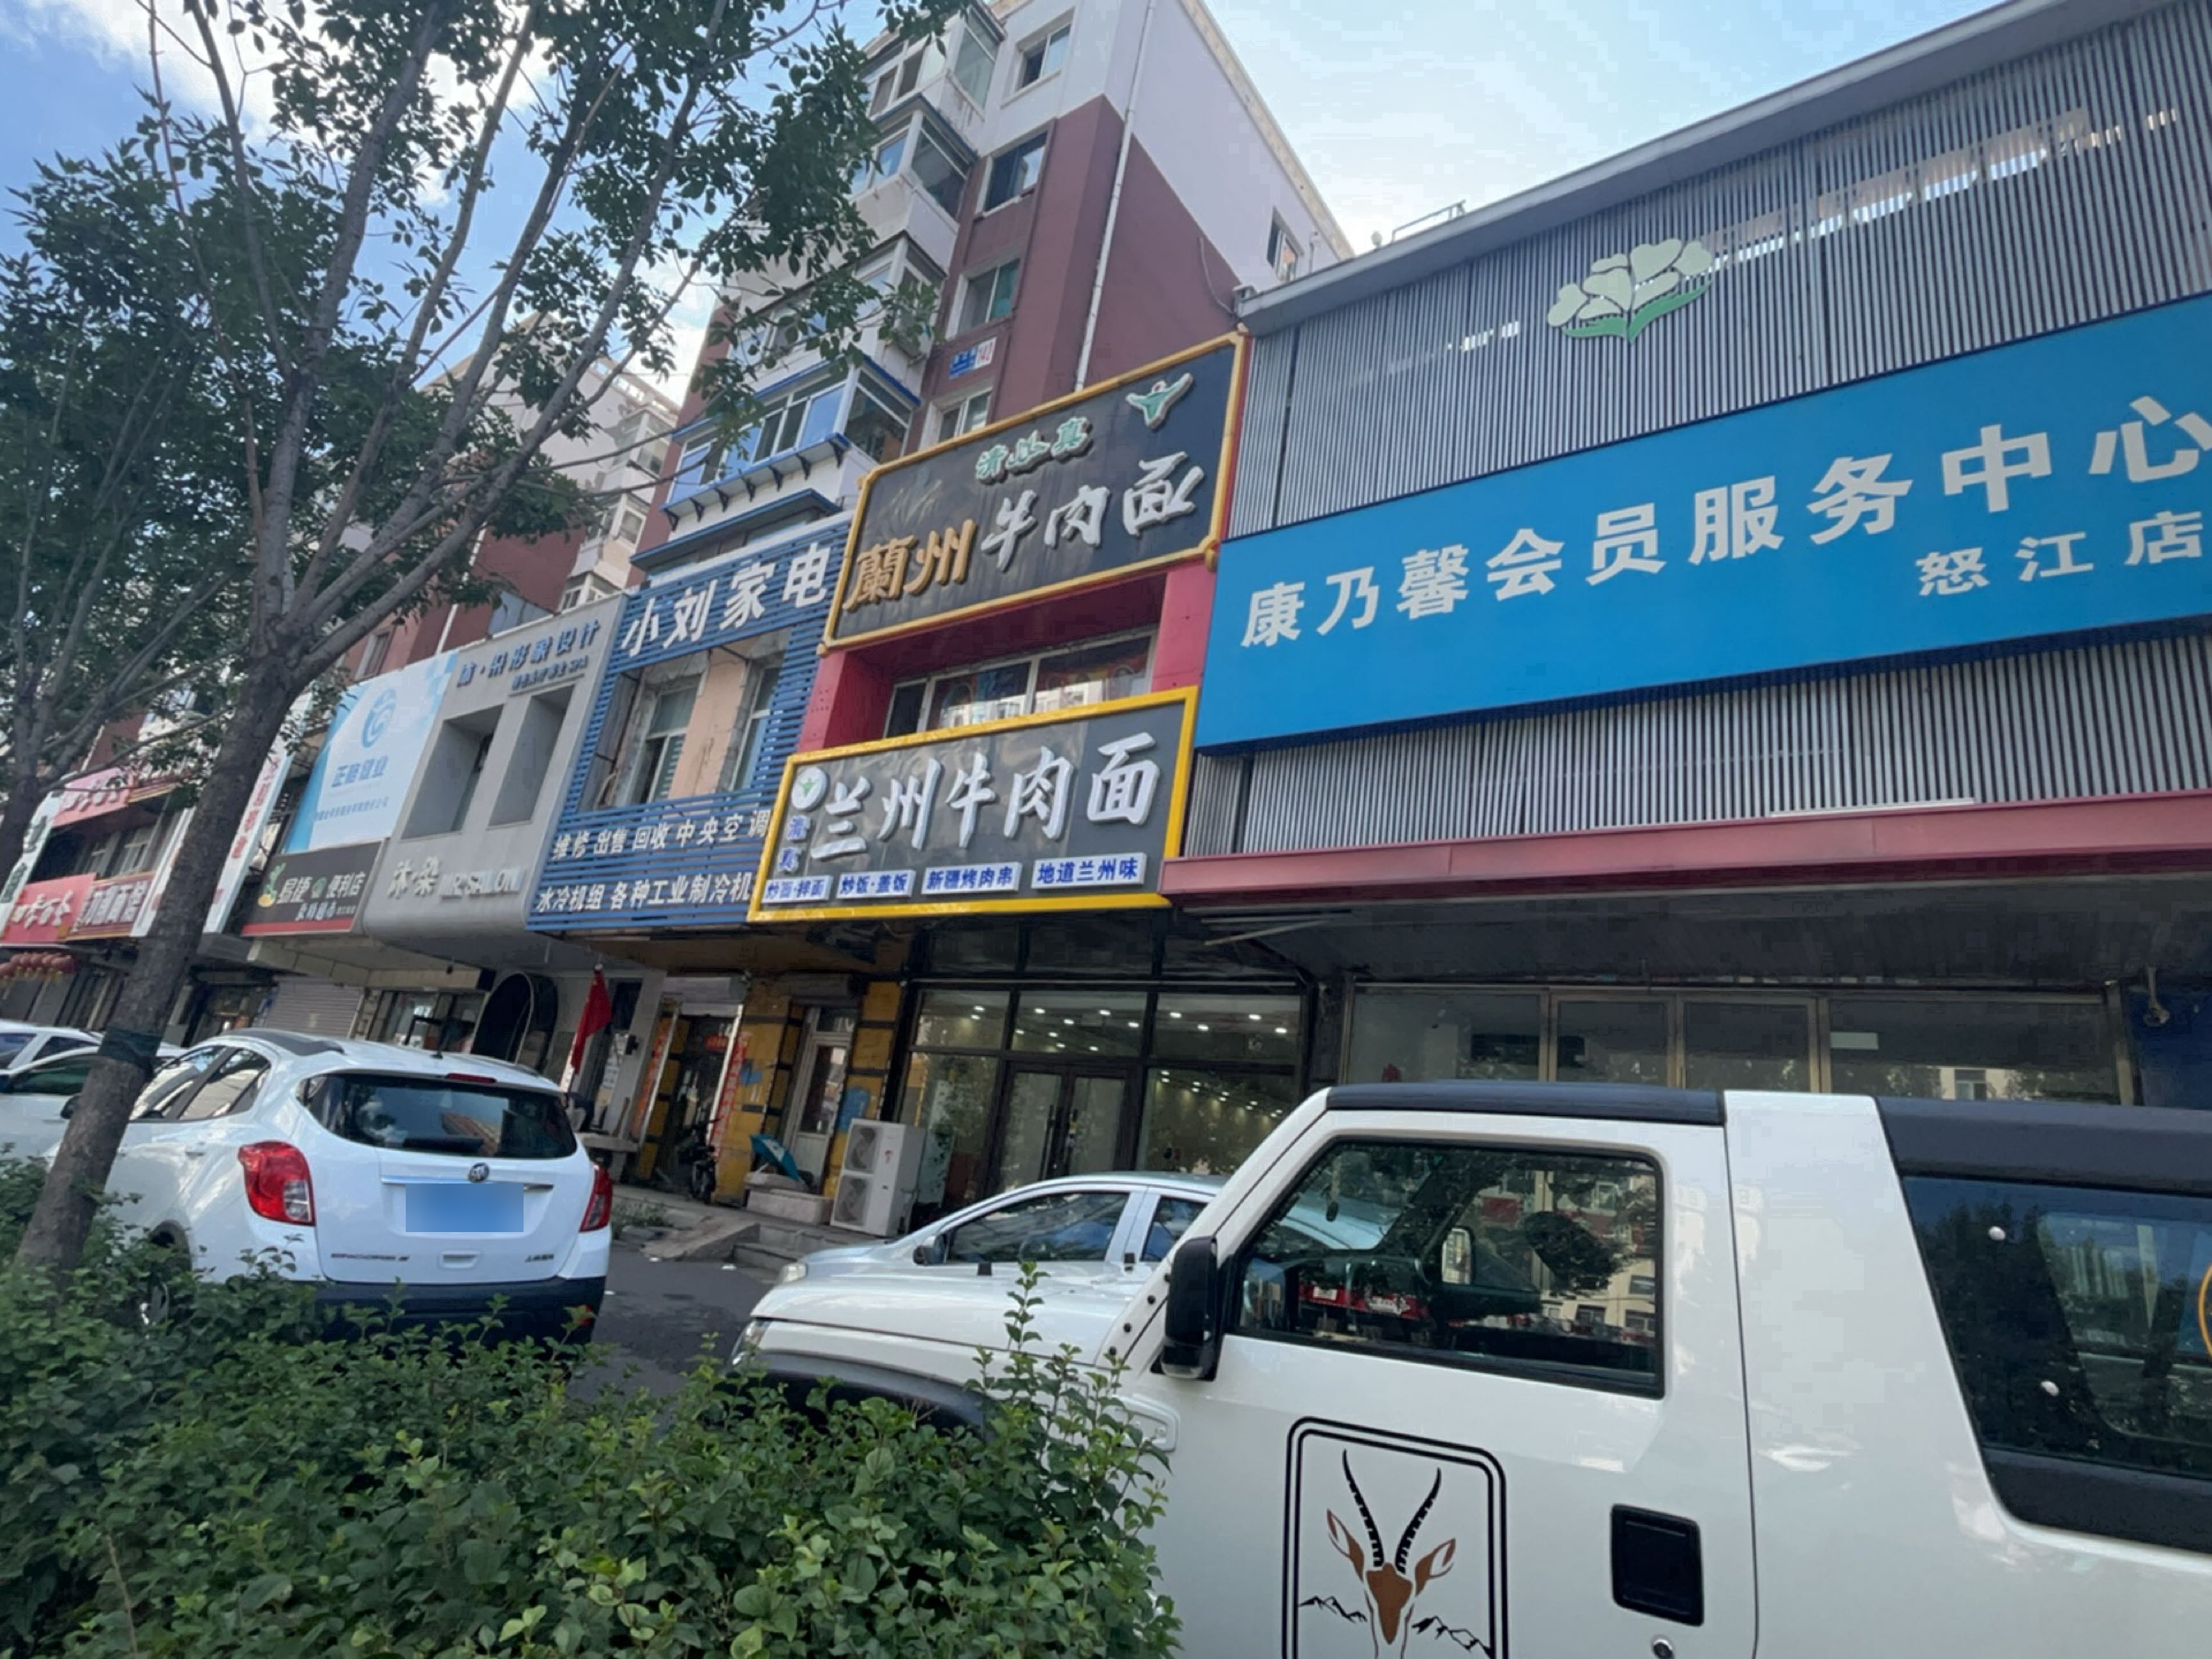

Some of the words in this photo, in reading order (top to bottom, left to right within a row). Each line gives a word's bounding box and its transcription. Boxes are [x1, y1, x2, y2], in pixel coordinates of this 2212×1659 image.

[1241, 394, 2212, 646] 康乃馨会员服务中心
[1914, 511, 2203, 597] 怒江店
[621, 541, 832, 657] 小刘家电
[811, 732, 1160, 860] 兰州牛肉面
[552, 830, 589, 861] 维修
[593, 826, 629, 854] 出售
[631, 822, 671, 850] 回收
[675, 809, 771, 847] 中央空调
[536, 883, 605, 913] 水冷机组
[610, 872, 753, 910] 各种工业制冷机
[927, 865, 1014, 890] 新疆烤肉串
[1036, 856, 1139, 885] 地道兰州味
